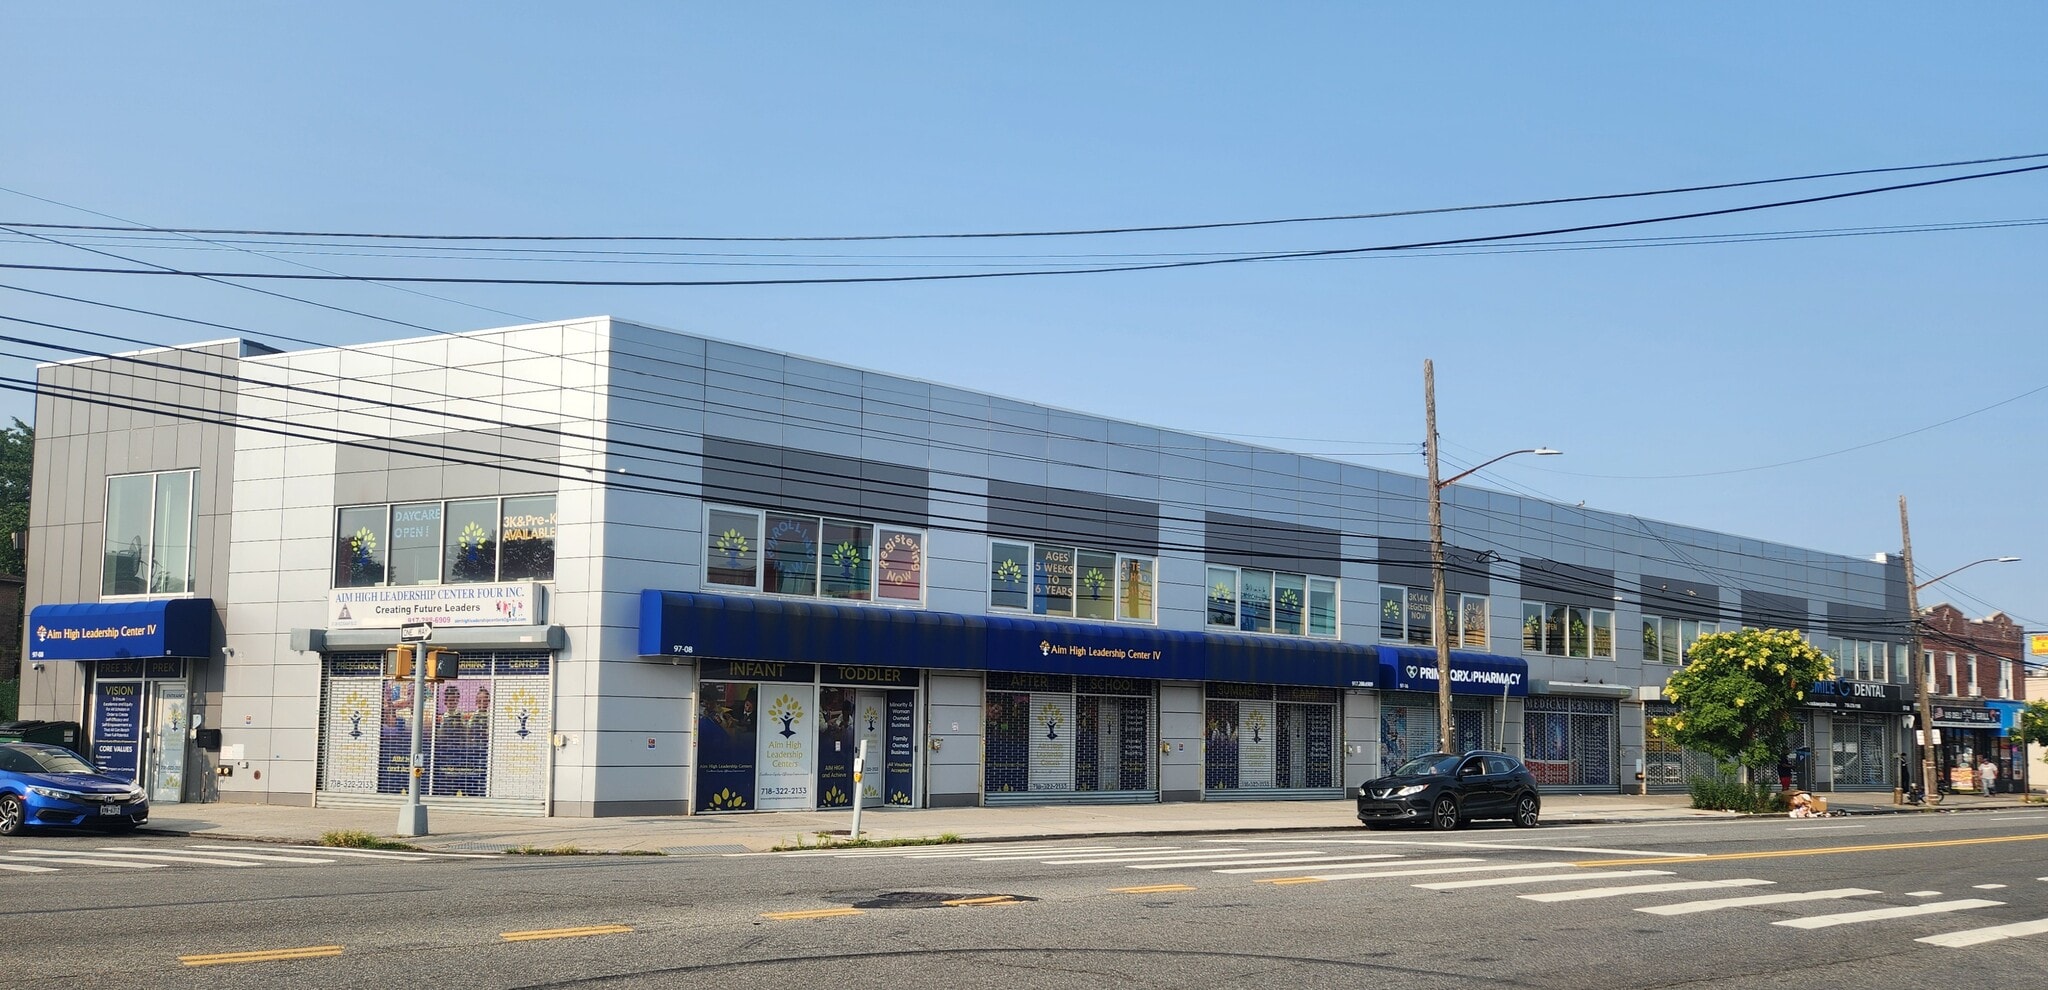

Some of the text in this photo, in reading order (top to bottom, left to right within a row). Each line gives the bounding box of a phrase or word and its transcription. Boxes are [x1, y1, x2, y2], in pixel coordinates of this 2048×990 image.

[395, 508, 440, 522] DAYCARE
[502, 527, 555, 541] AVAILABLE
[879, 534, 920, 571] Registering
[1036, 562, 1073, 574] 5 WEEKS
[1047, 574, 1059, 584] TO
[335, 586, 524, 602] AIM HIGH LEADERSHIP CENTER FOUR INC.
[1035, 584, 1073, 596] 6 YEARS
[376, 604, 480, 615] Creating Future Leaders
[1412, 612, 1426, 620] NOW
[46, 624, 156, 641] Aim High Leadership Center IV
[418, 628, 428, 636] WAY
[673, 645, 693, 653] 97-08
[1051, 645, 1161, 660] Aim High Leadership Center IV
[101, 662, 119, 672] FREE
[122, 662, 133, 672] 3K
[153, 662, 175, 672] PREK
[336, 661, 379, 670] PRESCHOOL
[509, 659, 539, 668] CENTER
[729, 662, 901, 682] INFANT TODDLER
[1473, 670, 1521, 685] PHARMACY
[1011, 676, 1136, 691] AFTER SCHOOL
[106, 686, 133, 696] VISION
[1854, 684, 1886, 698] DENTAL
[1525, 698, 1568, 710] MEDICAL
[786, 741, 802, 750] High
[767, 751, 803, 760] Leadership
[772, 760, 798, 768] Centers
[761, 787, 807, 795] 718-322-2133
